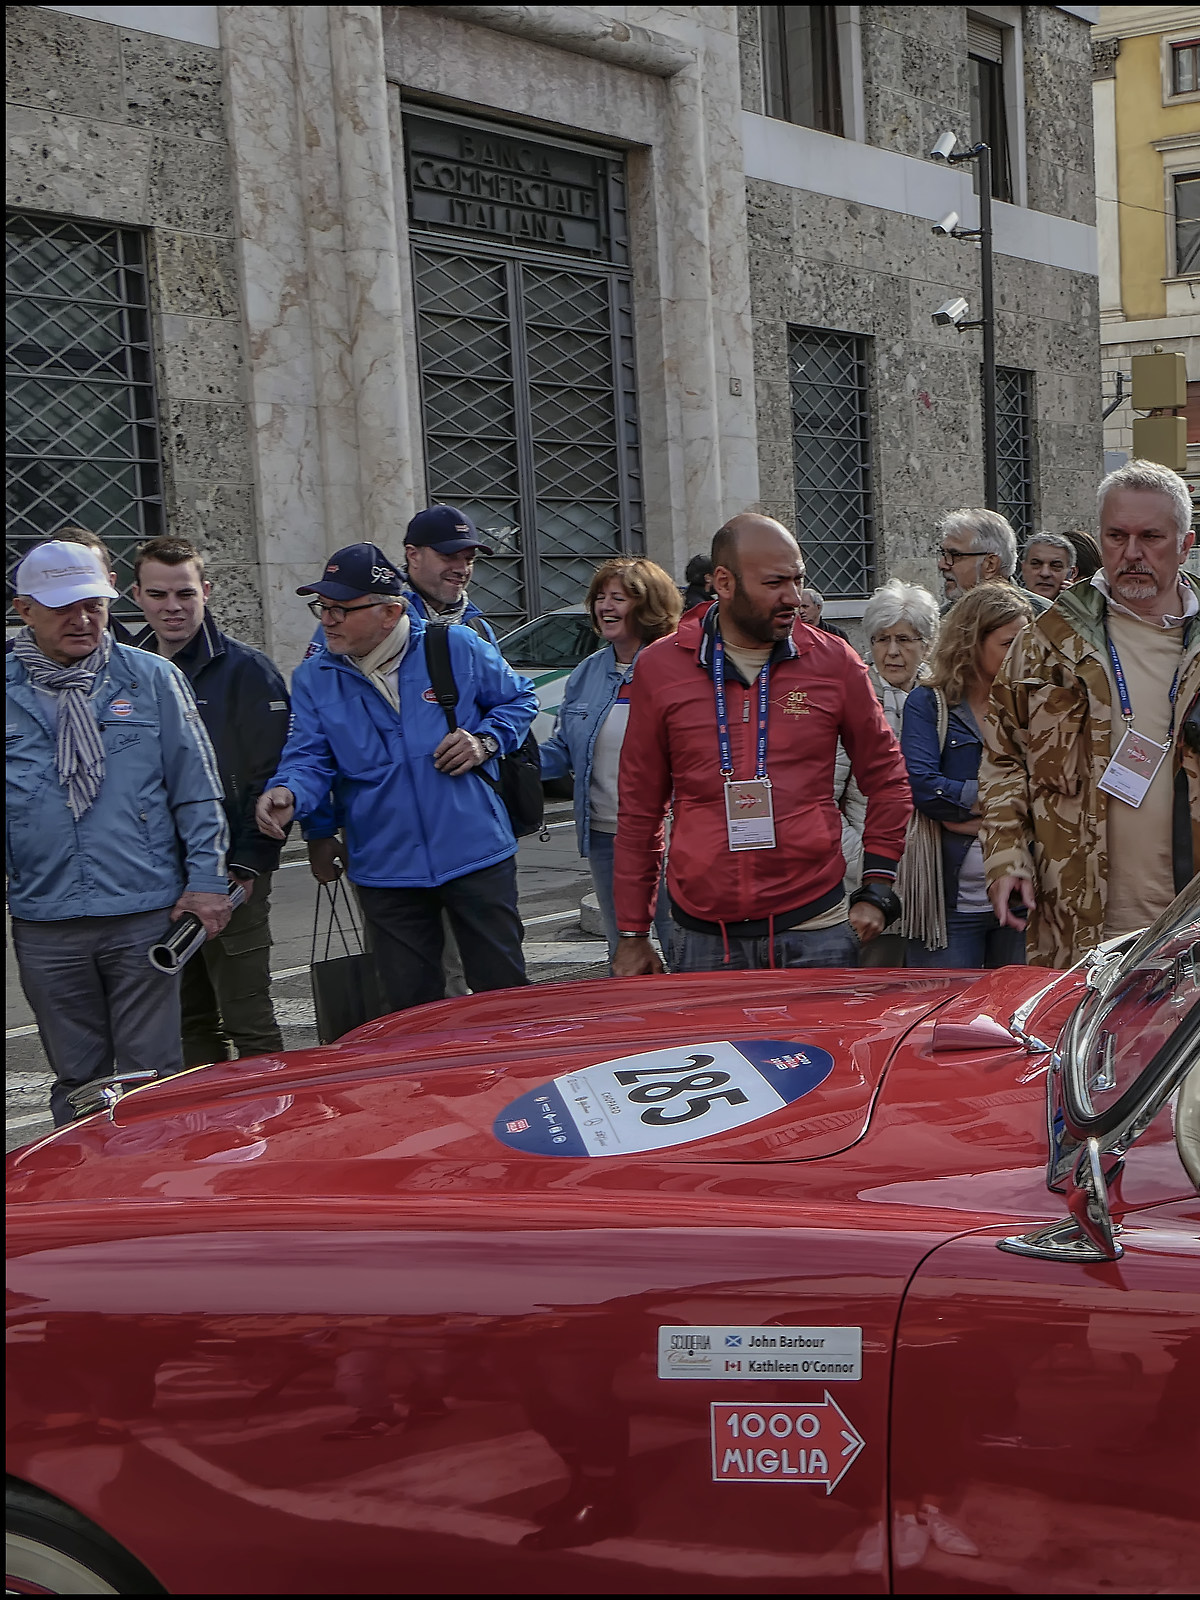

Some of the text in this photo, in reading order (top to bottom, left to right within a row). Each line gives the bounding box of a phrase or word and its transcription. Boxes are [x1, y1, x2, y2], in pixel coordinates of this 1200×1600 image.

[459, 136, 552, 177] BANCA
[414, 161, 594, 214] COMMERCIALE
[451, 199, 567, 242] ITALIANA
[613, 1053, 751, 1127] 285
[748, 1335, 826, 1348] John Barbour
[748, 1360, 854, 1373] Kathleen O'Connor
[726, 1413, 821, 1438] 1000
[721, 1448, 829, 1474] MIGLIA
